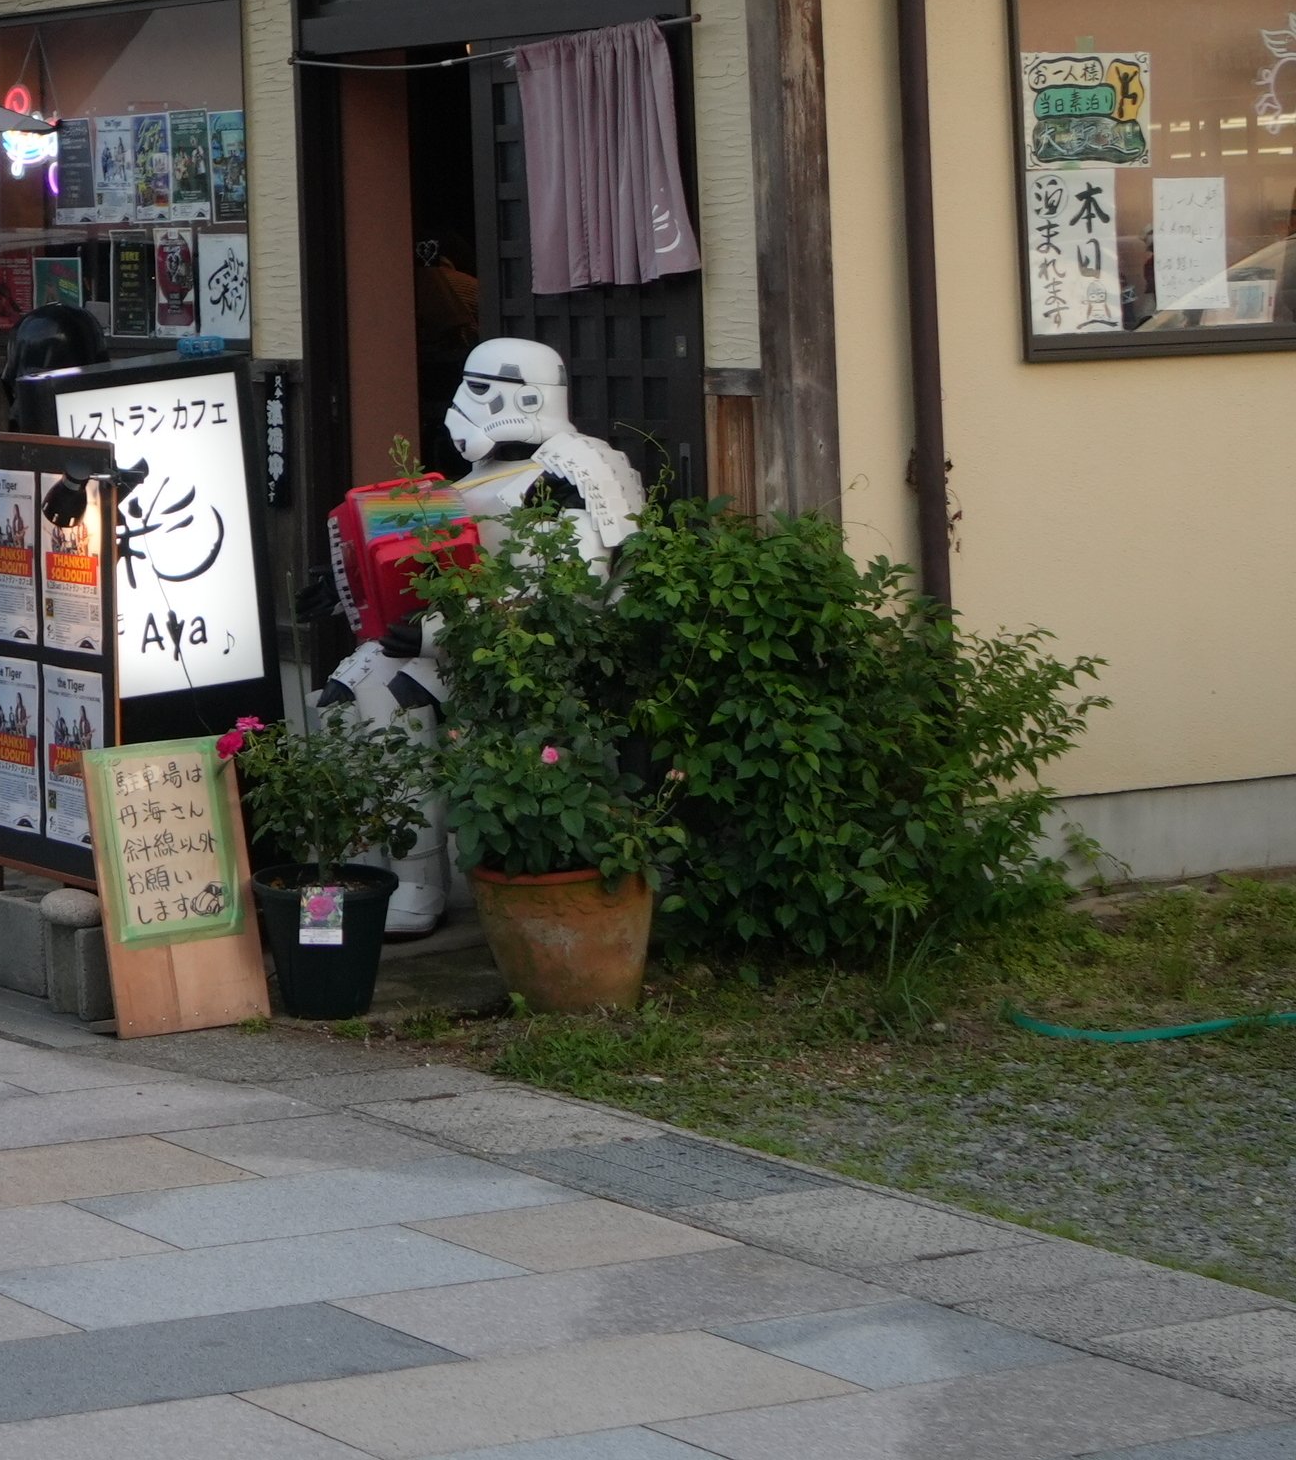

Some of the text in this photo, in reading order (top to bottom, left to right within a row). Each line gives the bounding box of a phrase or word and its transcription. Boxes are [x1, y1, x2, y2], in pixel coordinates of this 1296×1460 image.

[1033, 61, 1100, 86] お一人様
[1039, 89, 1114, 114] 当日素泊り
[1069, 182, 1110, 279] 本日
[1, 479, 17, 491] Tiger
[53, 554, 91, 570] THANKS!!
[51, 567, 93, 585] SOLDOUT!!
[5, 666, 22, 679] Tiger
[57, 677, 85, 692] the Tiger
[115, 761, 203, 796] 駐車場は
[116, 799, 204, 829] 丹海さん
[122, 828, 216, 864] 斜線以外
[126, 864, 193, 895] お願い
[137, 893, 190, 926] します
